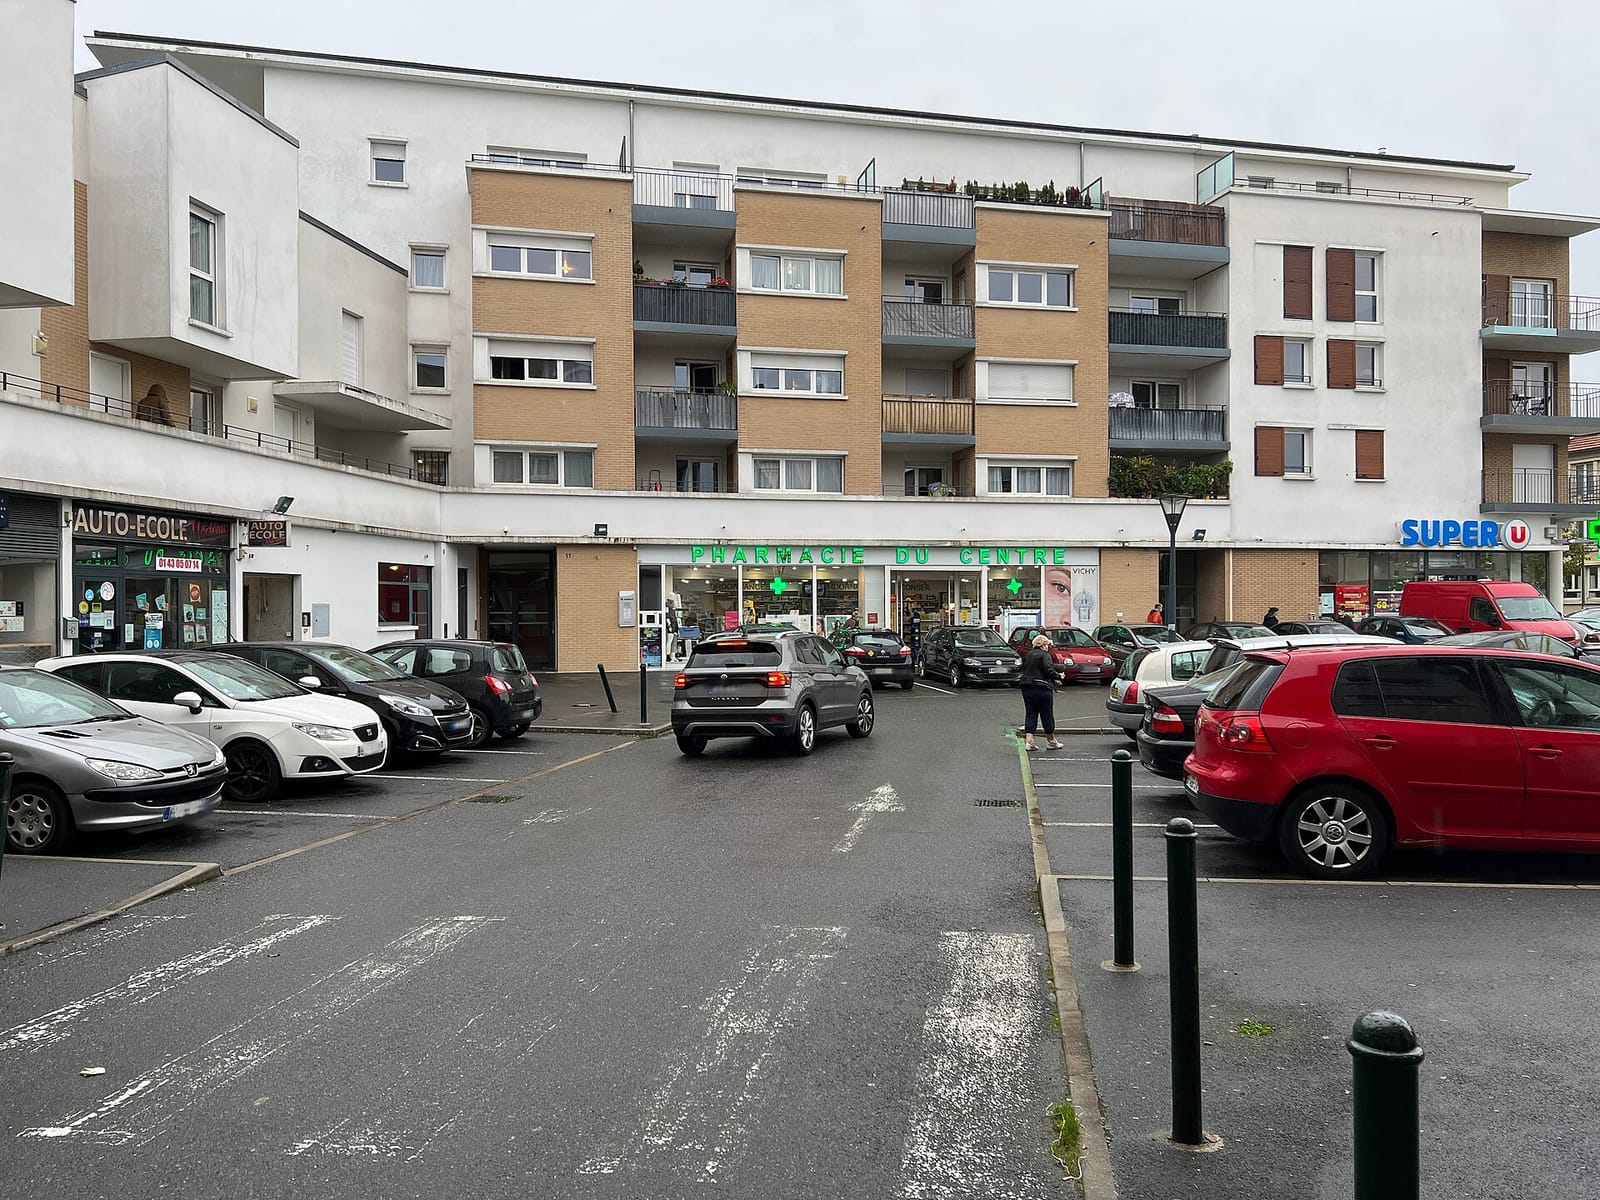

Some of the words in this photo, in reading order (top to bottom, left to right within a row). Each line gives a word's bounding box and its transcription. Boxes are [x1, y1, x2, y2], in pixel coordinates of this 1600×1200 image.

[74, 508, 188, 541] AUTO-ECOLE
[250, 521, 284, 531] AUTO
[249, 530, 286, 540] ECOLE
[1402, 519, 1499, 547] SUPER
[1510, 526, 1526, 544] U
[691, 546, 865, 564] PHARMACIE
[895, 547, 930, 565] DU
[959, 547, 1066, 565] CENTRE
[158, 557, 166, 568] 01
[167, 558, 175, 568] 43
[176, 559, 184, 569] 05
[185, 560, 192, 569] 07
[193, 560, 199, 569] 14
[1072, 567, 1096, 575] VICHY
